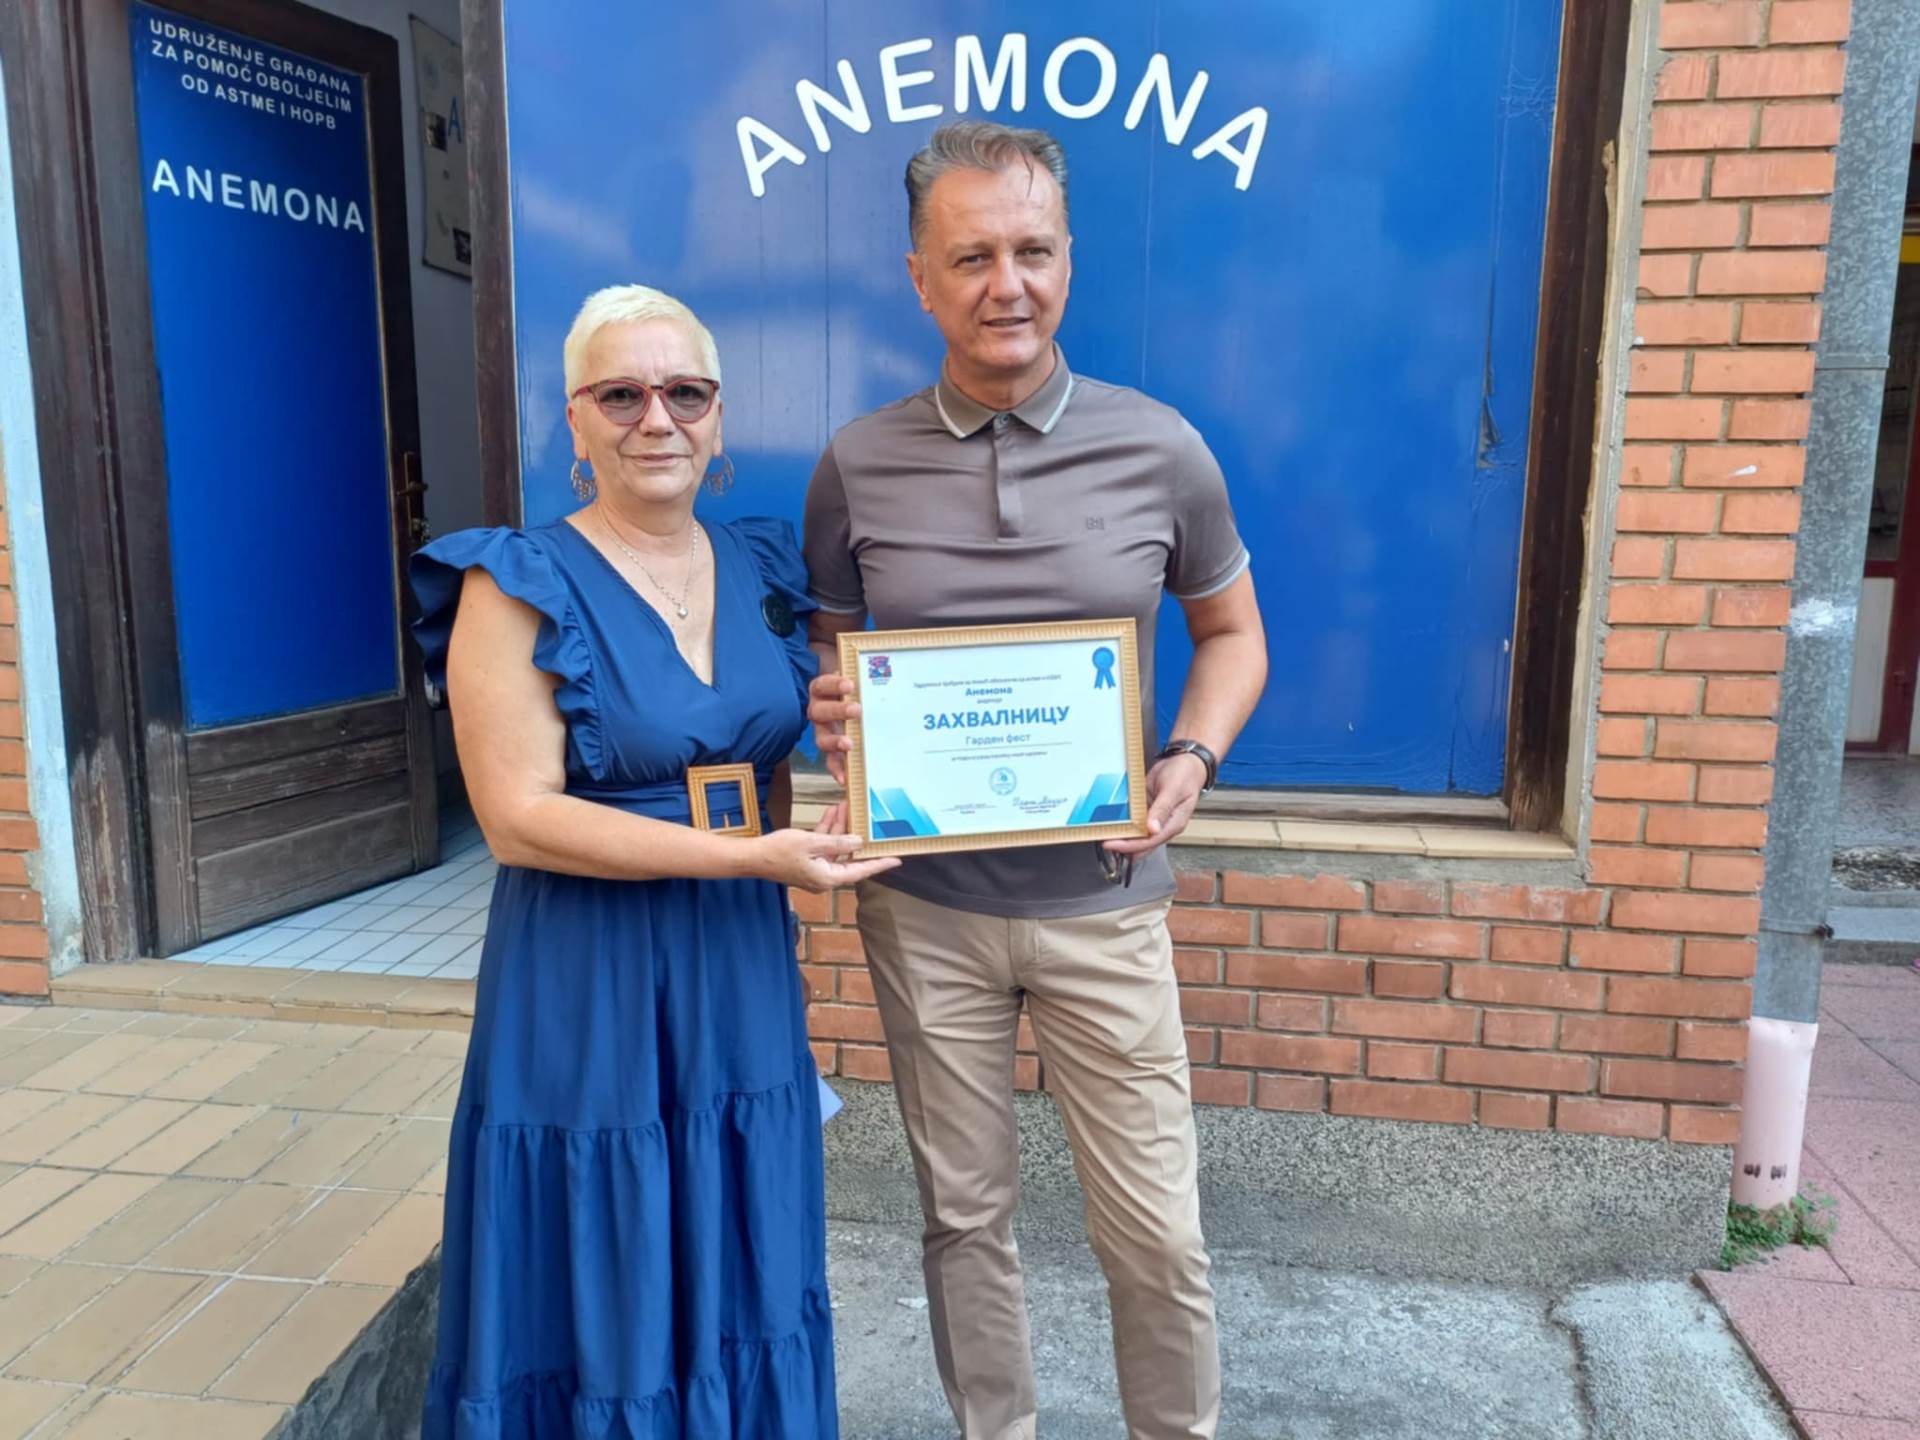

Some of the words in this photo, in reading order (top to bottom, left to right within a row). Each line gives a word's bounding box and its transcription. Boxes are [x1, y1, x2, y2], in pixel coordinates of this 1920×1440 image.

[150, 18, 265, 66] UDRUŽENJE
[269, 57, 351, 95] GRAĐANA
[151, 40, 178, 62] ZA
[183, 49, 252, 83] POMOĆ
[255, 72, 352, 113] OBOLJELIM
[181, 74, 209, 94] OD
[214, 83, 276, 114] ASTME
[280, 102, 286, 116] I
[290, 106, 337, 130] HOPB
[736, 33, 1268, 197] ANEMONA
[152, 158, 365, 233] ANEMONA
[923, 706, 1070, 730] ЗАХВАЛНИЦУ
[965, 687, 1013, 697] Анемона
[965, 735, 1004, 746] Гарден
[1006, 733, 1031, 744] фест
